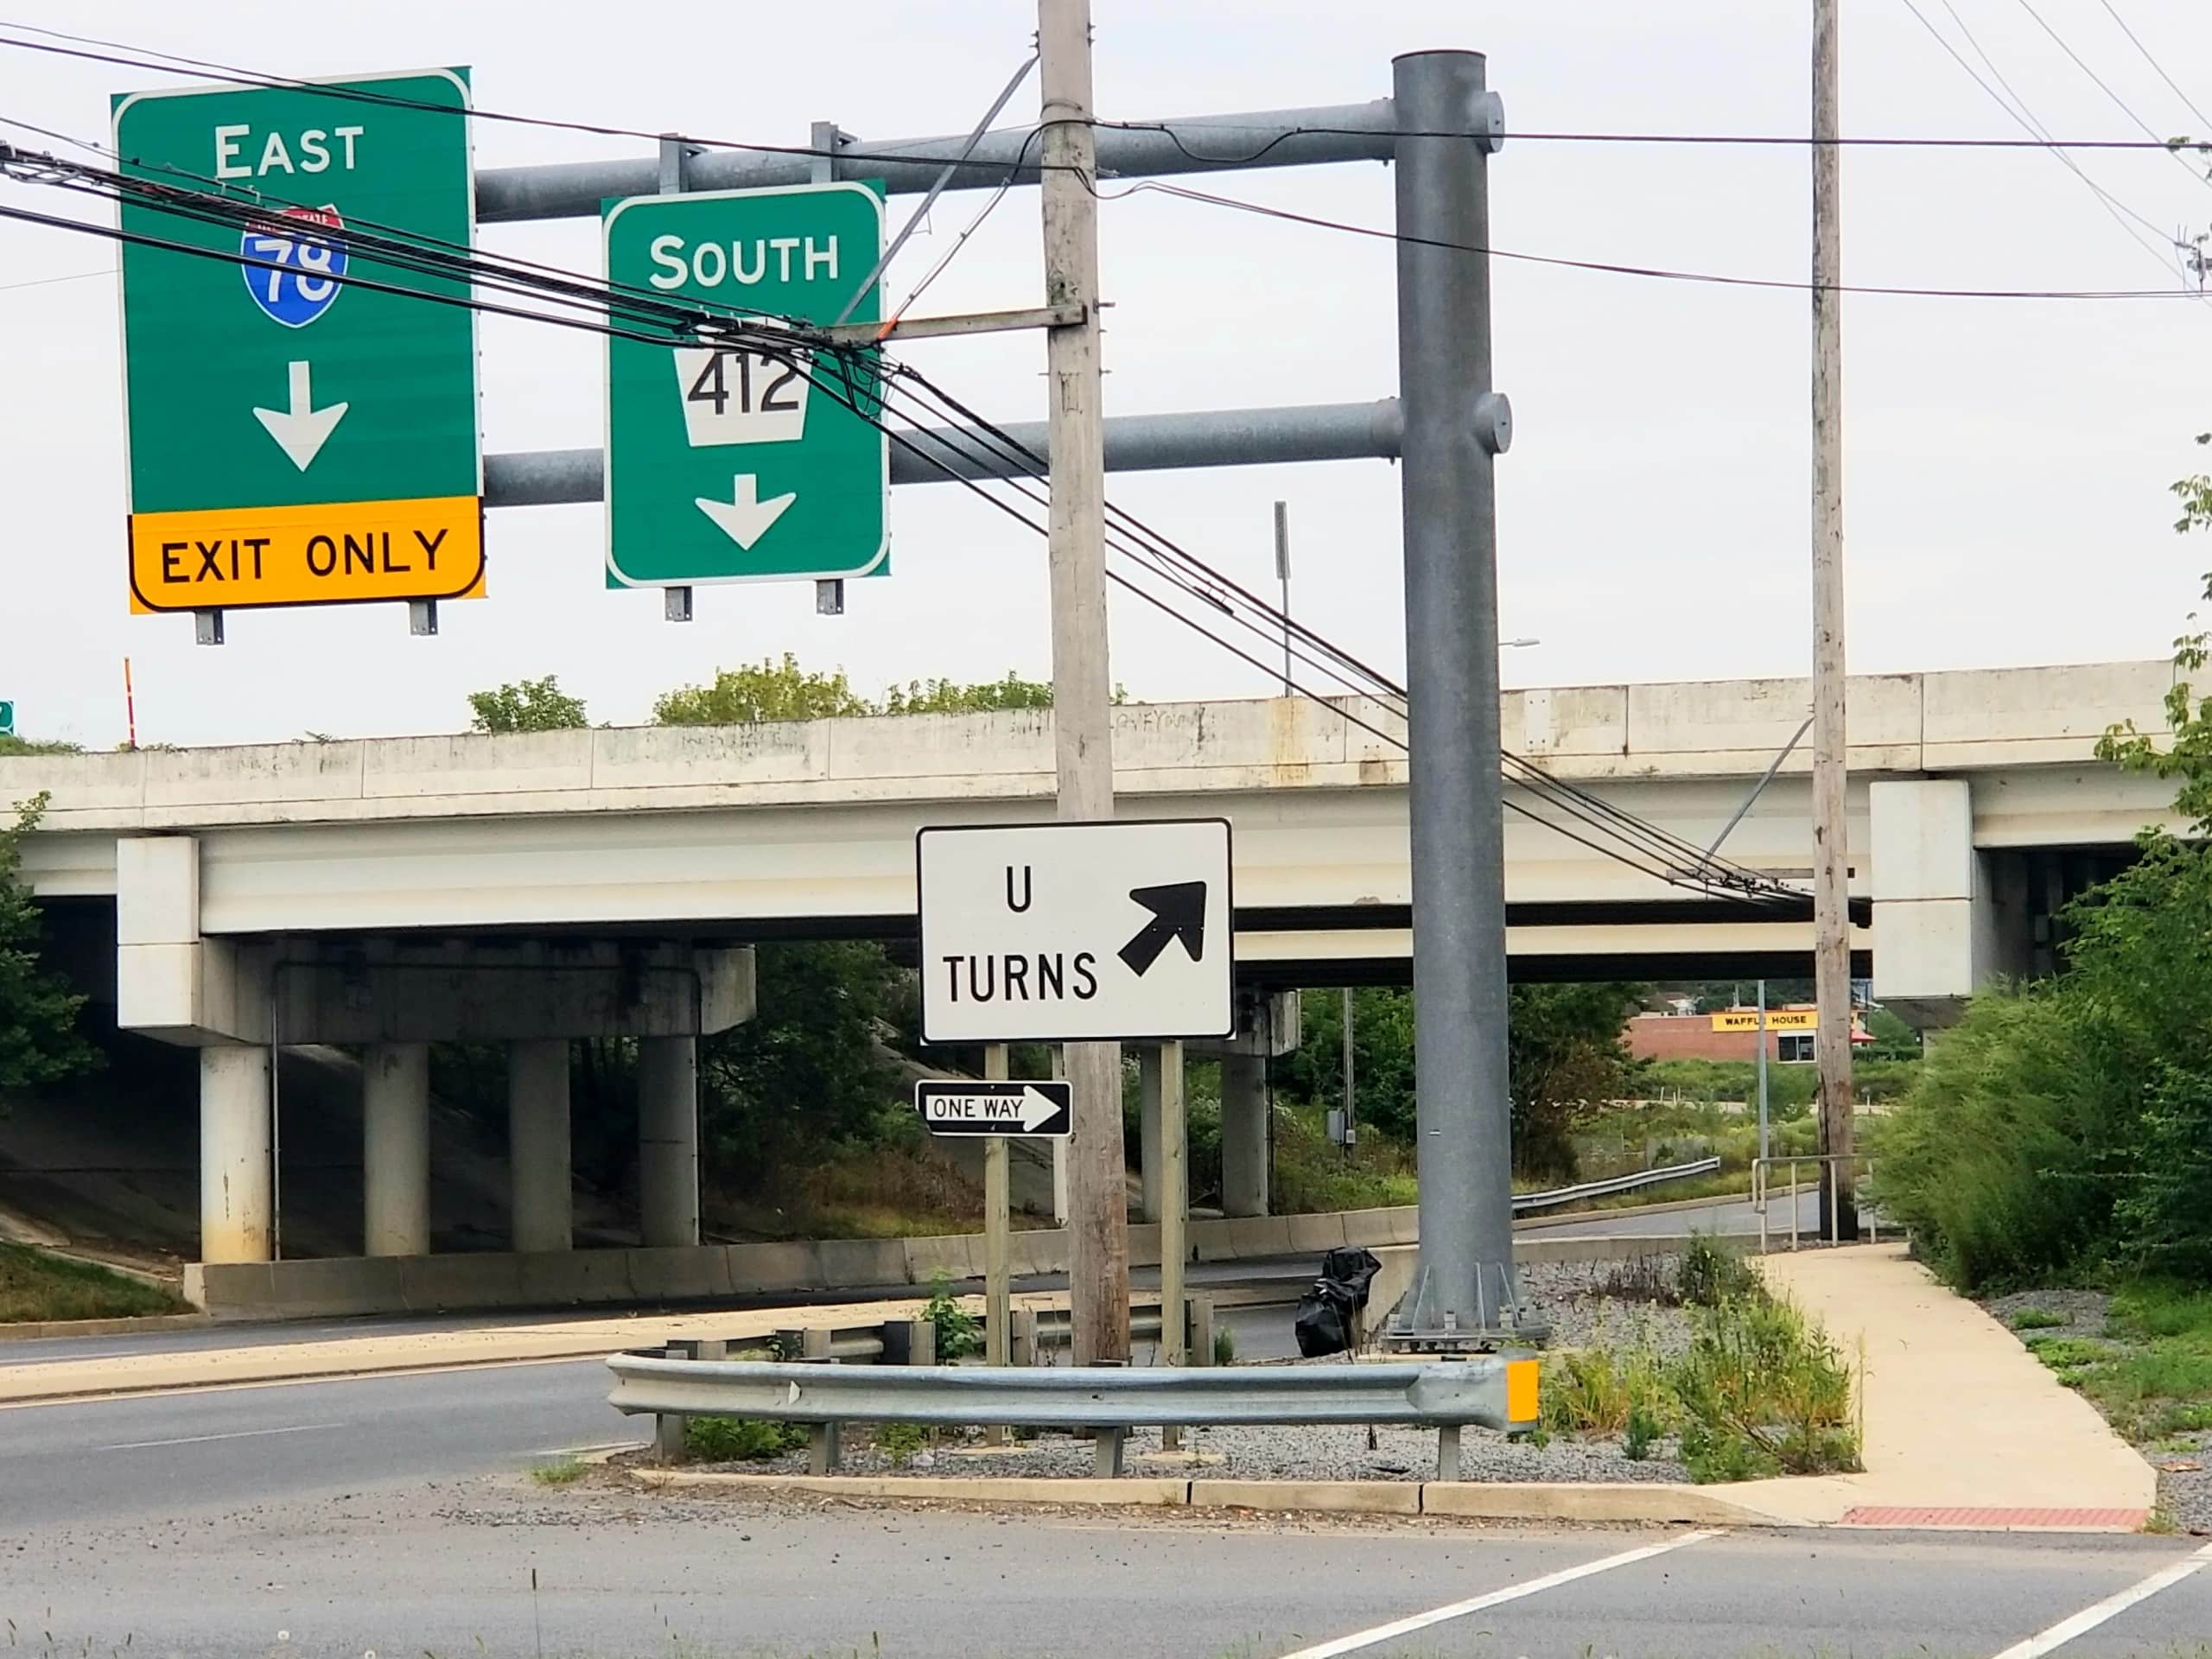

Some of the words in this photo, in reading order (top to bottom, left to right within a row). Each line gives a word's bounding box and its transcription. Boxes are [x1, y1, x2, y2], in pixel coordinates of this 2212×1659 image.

[214, 124, 364, 178] EAST
[255, 238, 334, 302] 78
[649, 234, 838, 289] SOUTH
[688, 349, 798, 415] 412
[162, 537, 270, 585] EXIT
[306, 528, 448, 576] ONLY
[1006, 865, 1032, 913] U
[942, 952, 1098, 1002] TURNS
[1725, 1017, 1765, 1026] WAFFL
[1771, 1015, 1807, 1024] HOUSE
[934, 1098, 976, 1117] ONE
[983, 1098, 1024, 1118] WAY
